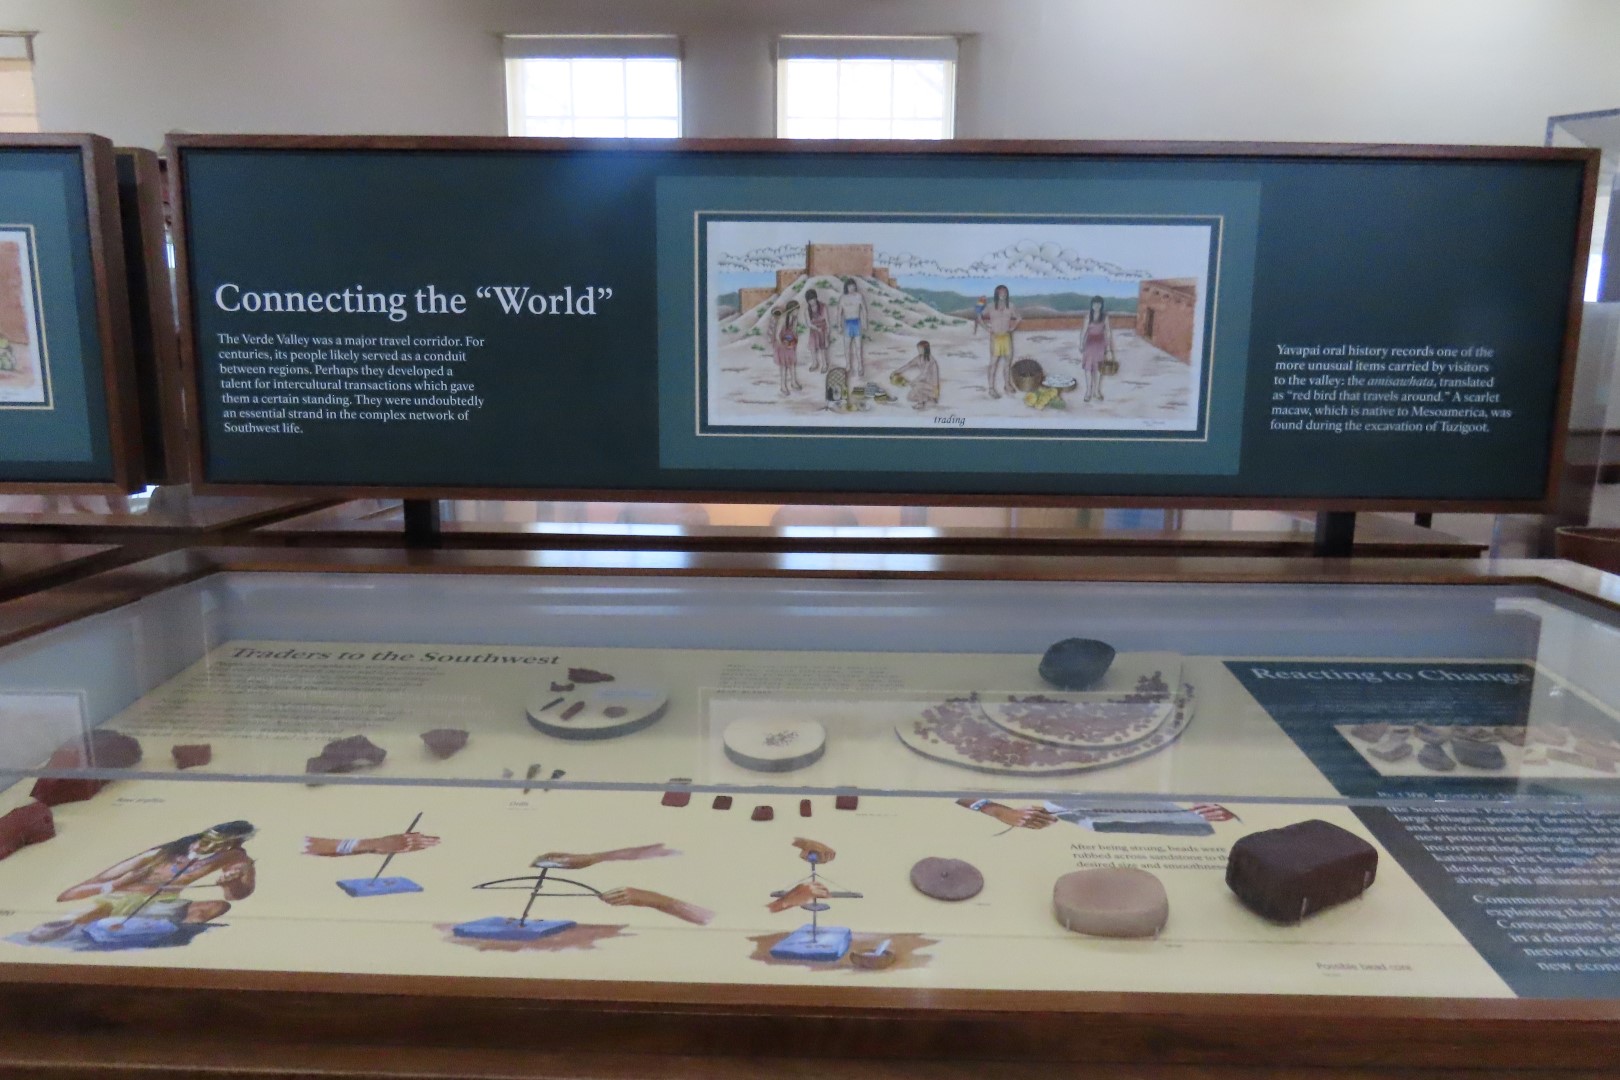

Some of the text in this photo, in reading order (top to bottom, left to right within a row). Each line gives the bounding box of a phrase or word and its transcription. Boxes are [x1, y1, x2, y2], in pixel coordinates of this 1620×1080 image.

[215, 284, 612, 322] Connecting the “World”
[218, 334, 484, 348] The Verde Valley was a major travel corridor. For
[219, 350, 466, 362] centuries, its people likely served as a conduit
[1277, 345, 1493, 358] Yavapai oral history records one of the
[220, 364, 453, 377] between regions. Perhaps they developed a
[1275, 360, 1489, 374] more unusual items carried by visitors
[221, 379, 474, 393] talent for intercultural transactions which gave
[1274, 376, 1285, 385] to
[1288, 375, 1306, 385] the
[1309, 375, 1344, 388] valley:
[1347, 375, 1365, 385] the
[1440, 377, 1494, 387] translated
[222, 393, 484, 407] them a certain standing. They were undoubtedly
[1273, 391, 1284, 401] as
[1314, 390, 1336, 400] bird
[1339, 390, 1360, 400] that
[1363, 391, 1398, 401] travels
[1452, 392, 1461, 402] A
[1464, 392, 1499, 402] scarlet
[223, 408, 469, 421] an essential strand in the complex network of
[1272, 405, 1511, 418] macaw, which is native to Mesoamerica, was
[934, 414, 965, 426] trading
[224, 422, 303, 433] Southwest life.
[1270, 420, 1489, 434] found during the excavation of Tuzigoot.
[233, 648, 561, 664] Traders to the Southwest
[1251, 669, 1382, 684] Reacting
[1384, 669, 1412, 682] to
